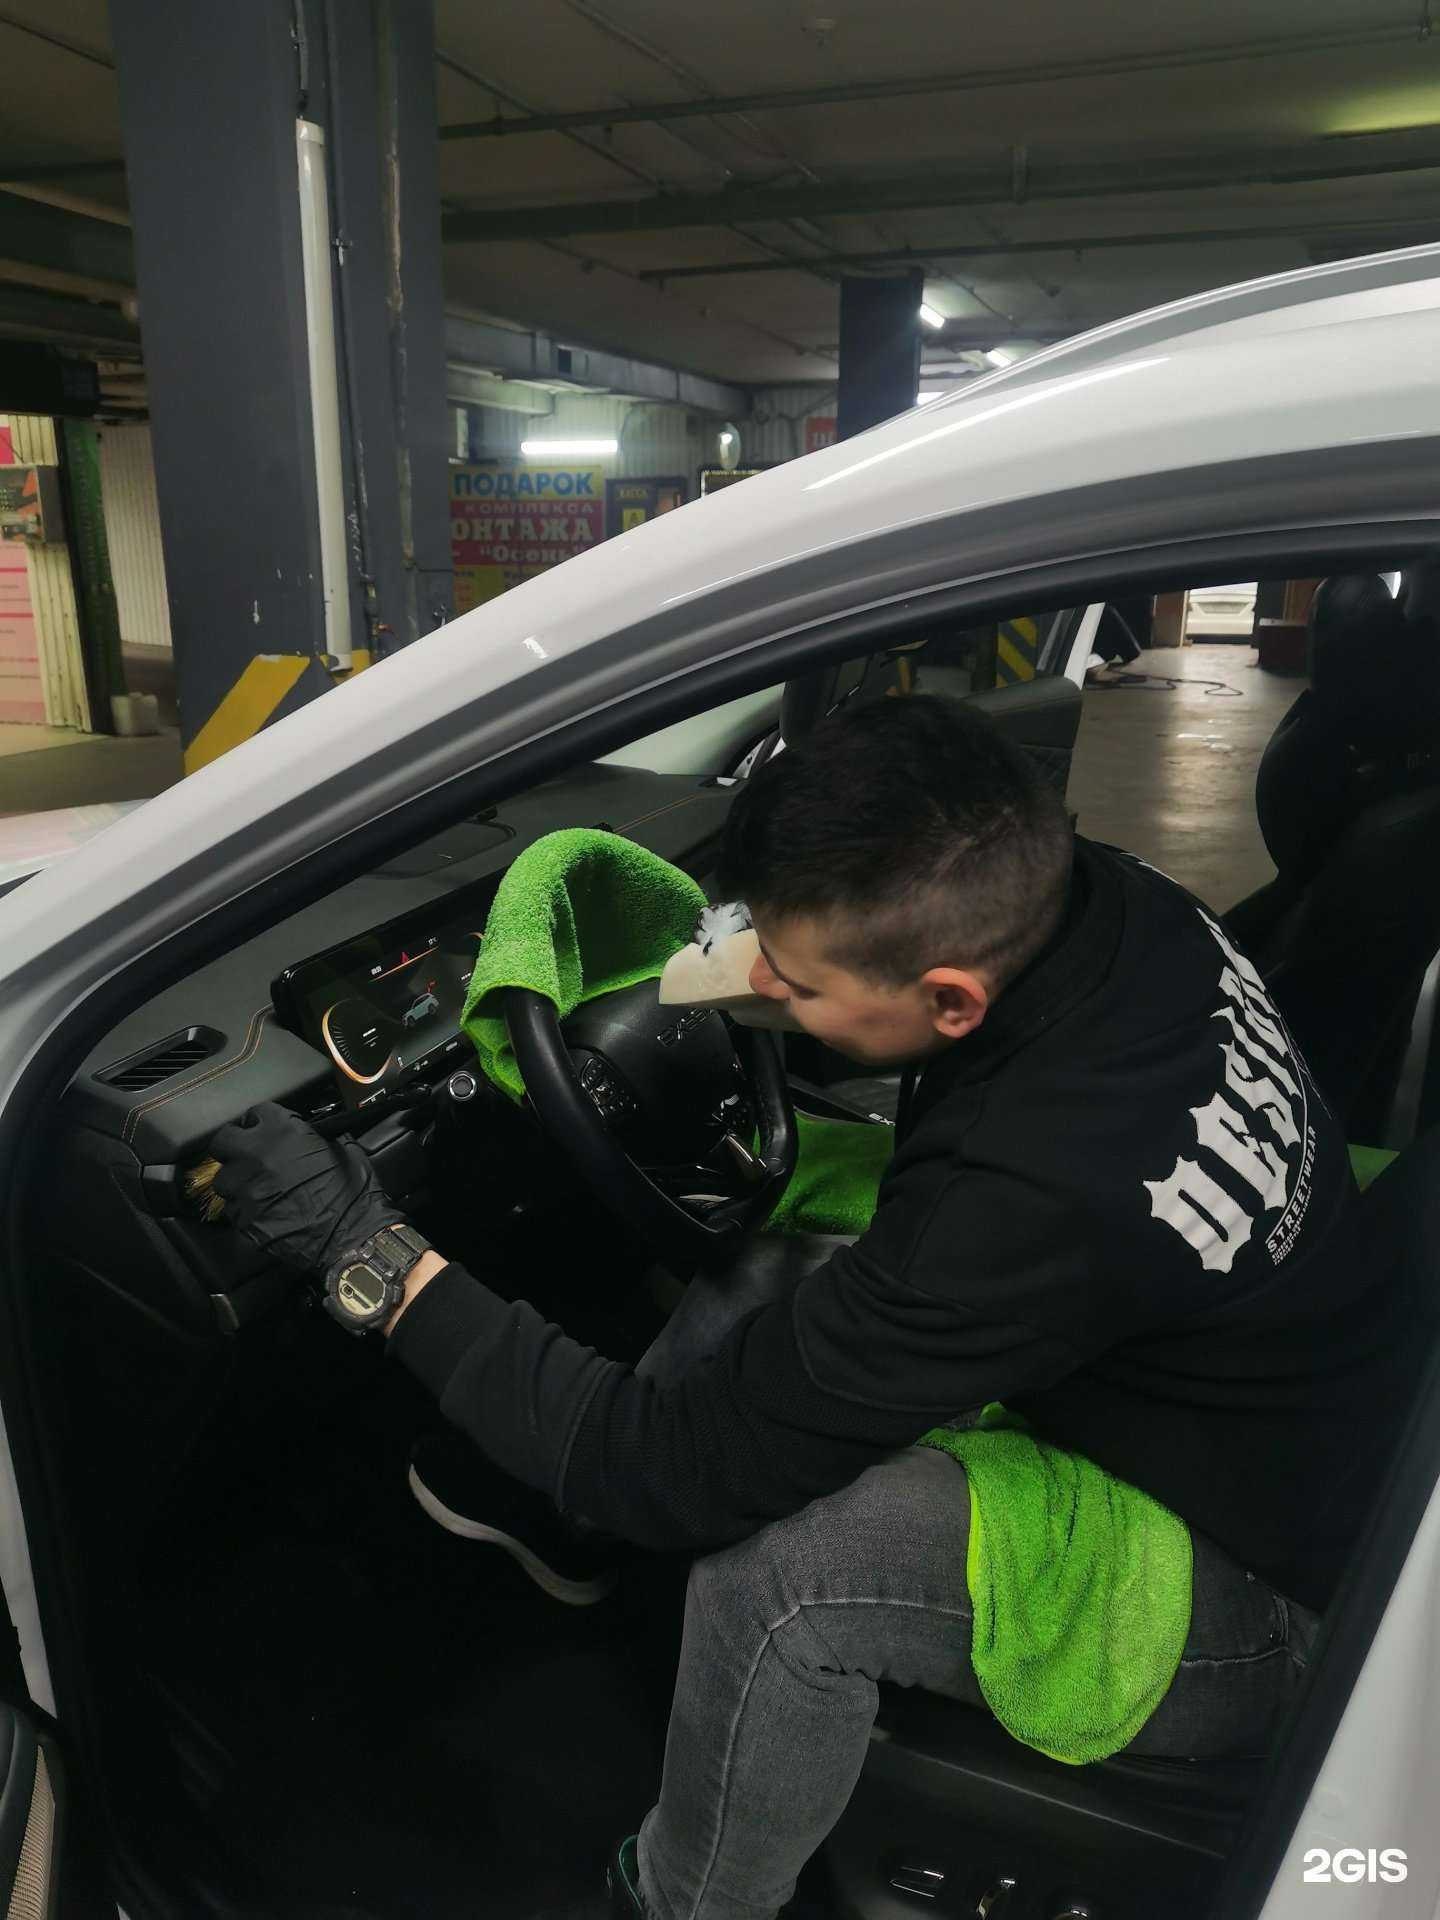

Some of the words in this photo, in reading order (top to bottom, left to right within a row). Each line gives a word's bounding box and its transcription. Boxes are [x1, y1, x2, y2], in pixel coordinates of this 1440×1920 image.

[454, 472, 593, 498] ПОДАРОК
[465, 502, 594, 514] КОМПЛЕКСА
[1267, 1125, 1317, 1253] STREETWEAR
